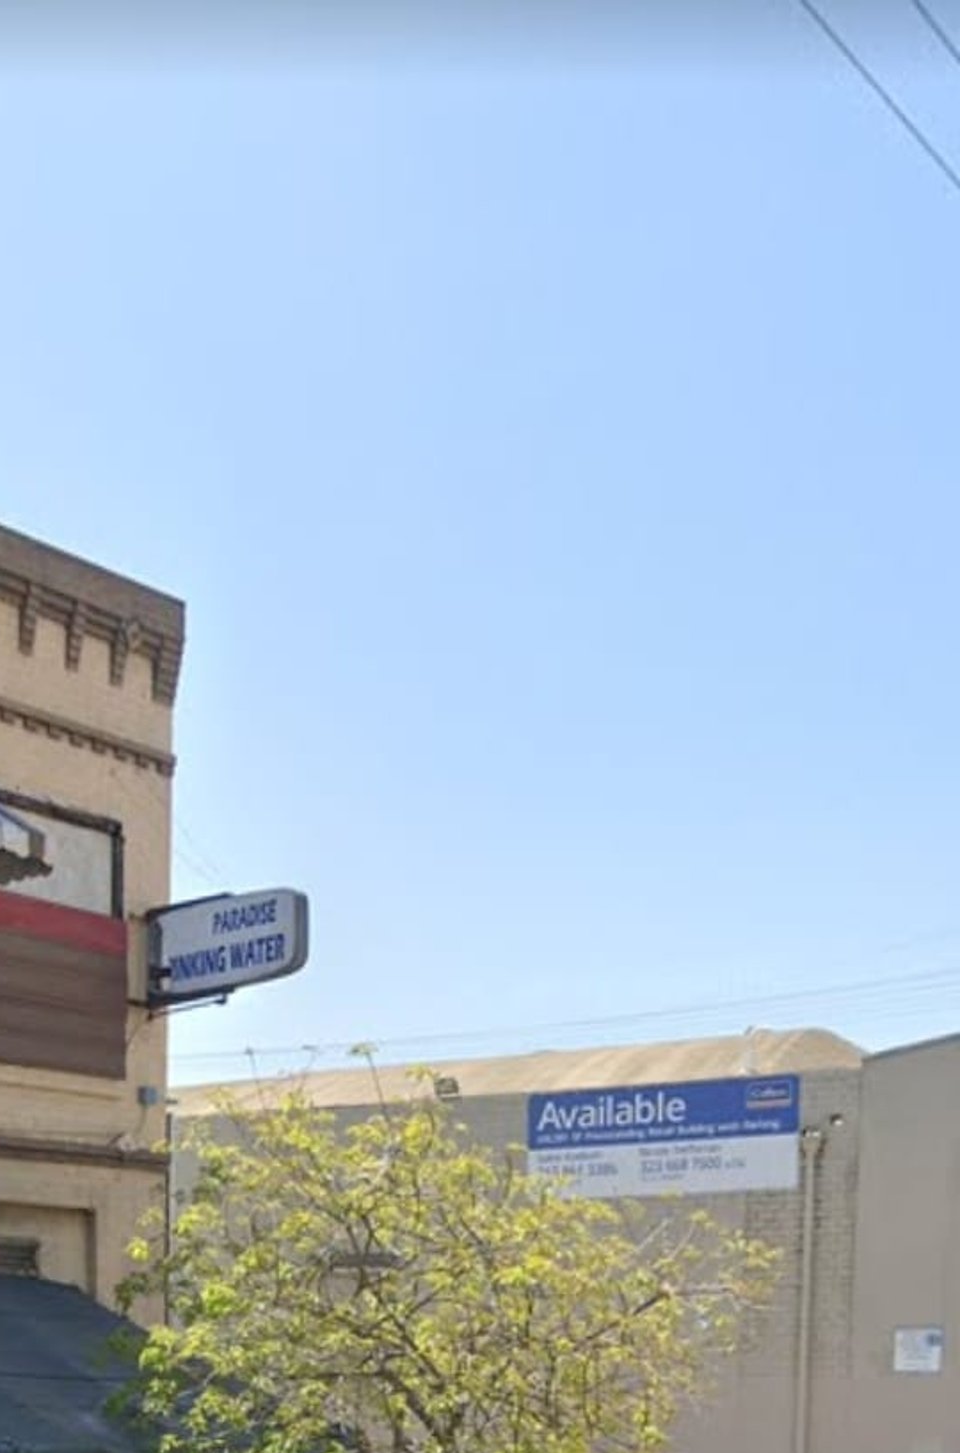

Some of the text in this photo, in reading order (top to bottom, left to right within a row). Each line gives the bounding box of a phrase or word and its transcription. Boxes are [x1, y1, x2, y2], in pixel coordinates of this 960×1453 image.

[212, 898, 278, 934] PARADISE
[230, 933, 285, 969] WATER
[536, 1091, 687, 1131] Available
